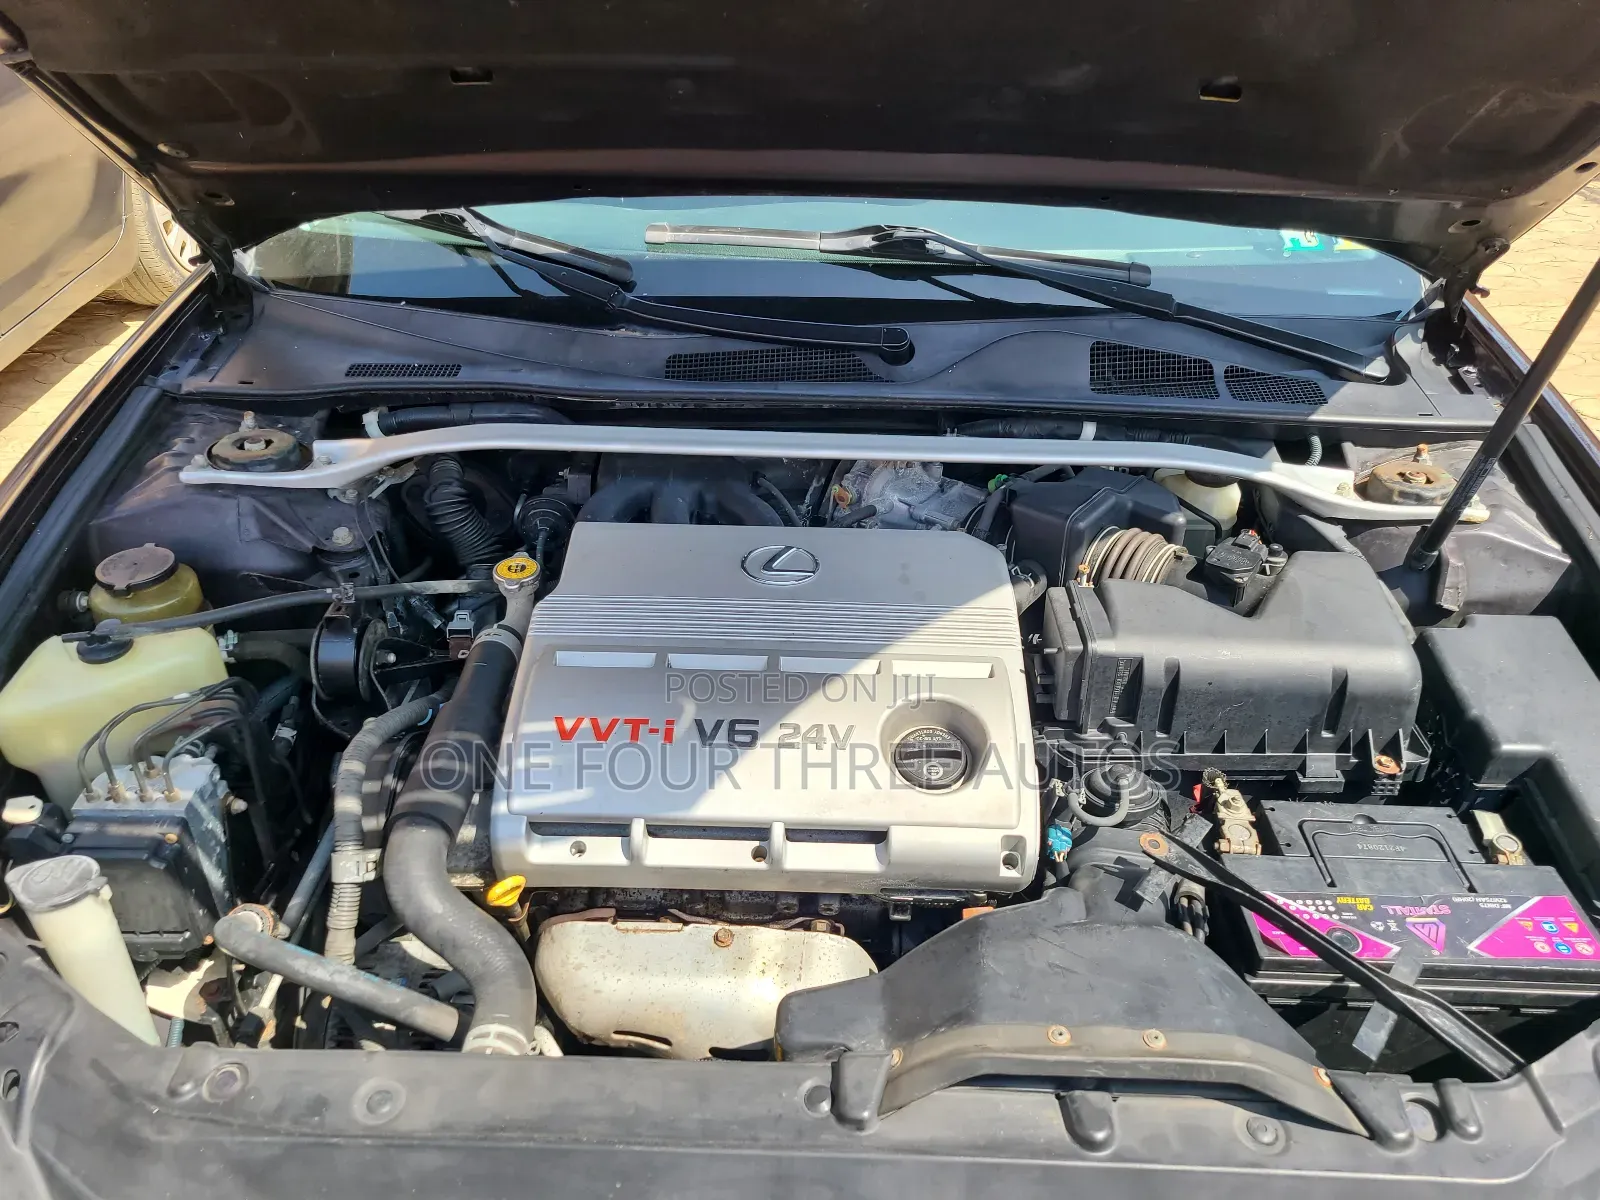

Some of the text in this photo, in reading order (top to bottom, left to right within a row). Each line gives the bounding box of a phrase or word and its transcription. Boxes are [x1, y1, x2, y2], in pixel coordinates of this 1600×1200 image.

[554, 716, 856, 750] VVT-i V6 24V
[1337, 896, 1370, 904] BATTERY
[1357, 903, 1374, 912] CAR
[1381, 904, 1451, 915] STARTALL
